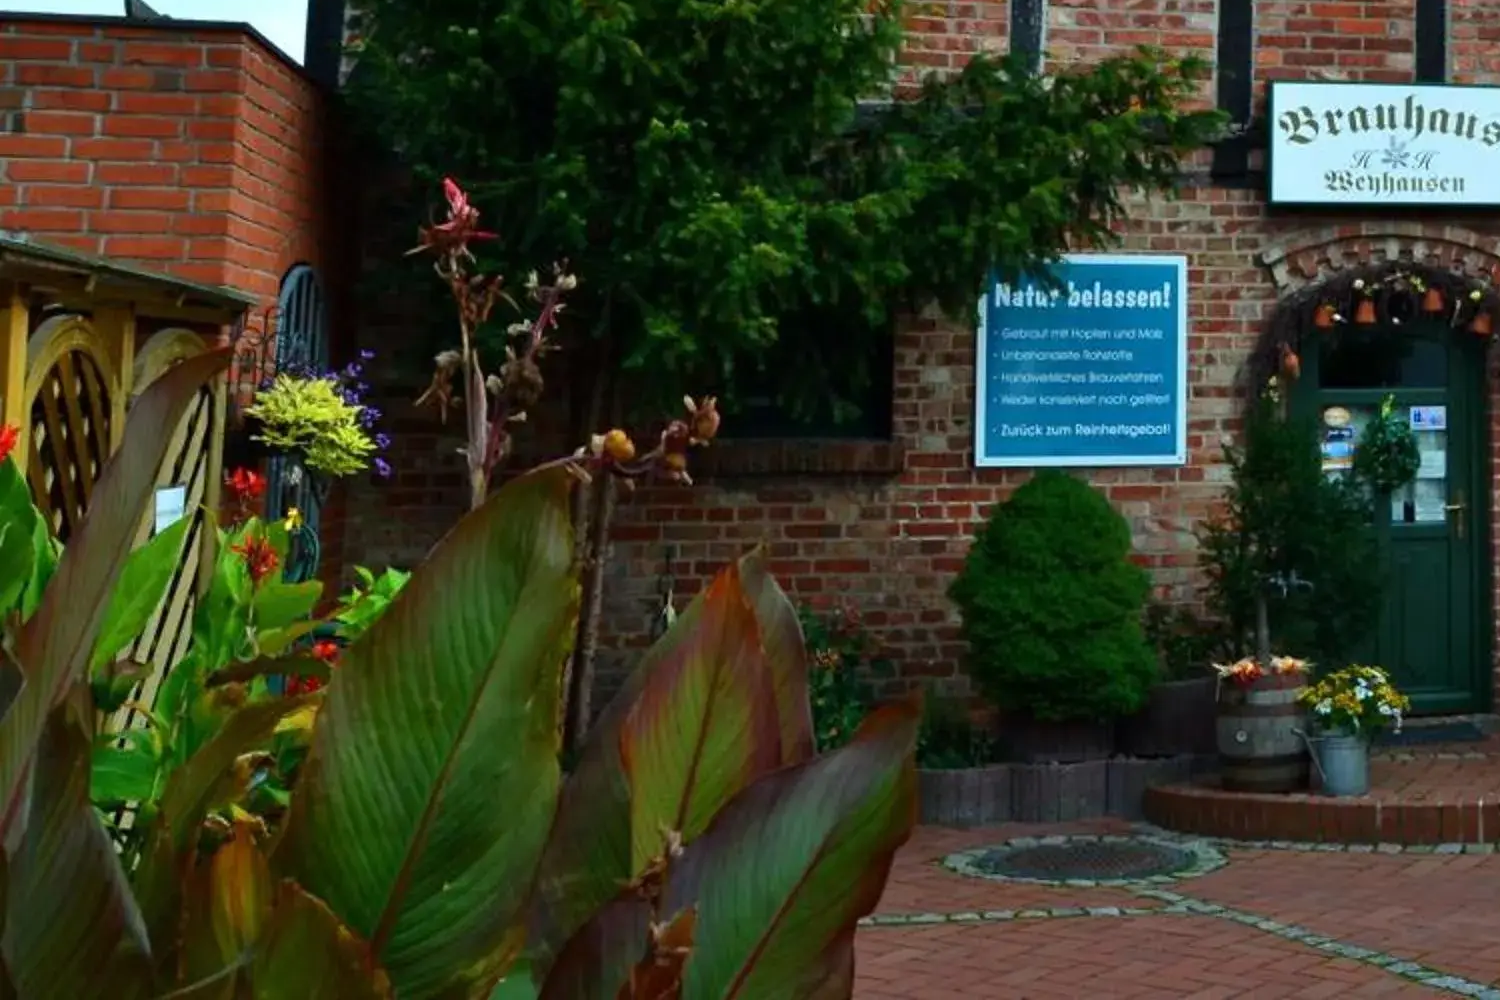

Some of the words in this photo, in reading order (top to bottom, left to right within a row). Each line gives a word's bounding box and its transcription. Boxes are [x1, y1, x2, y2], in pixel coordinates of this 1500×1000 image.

[1323, 169, 1466, 197] Weyhausen
[995, 282, 1060, 308] Natur
[1067, 281, 1171, 308] belassen!
[1113, 329, 1137, 339] und
[1138, 328, 1164, 339] Malz
[1001, 424, 1042, 437] Zurück
[1046, 425, 1072, 436] zum
[1075, 424, 1171, 438] Reinheitsgebot!
